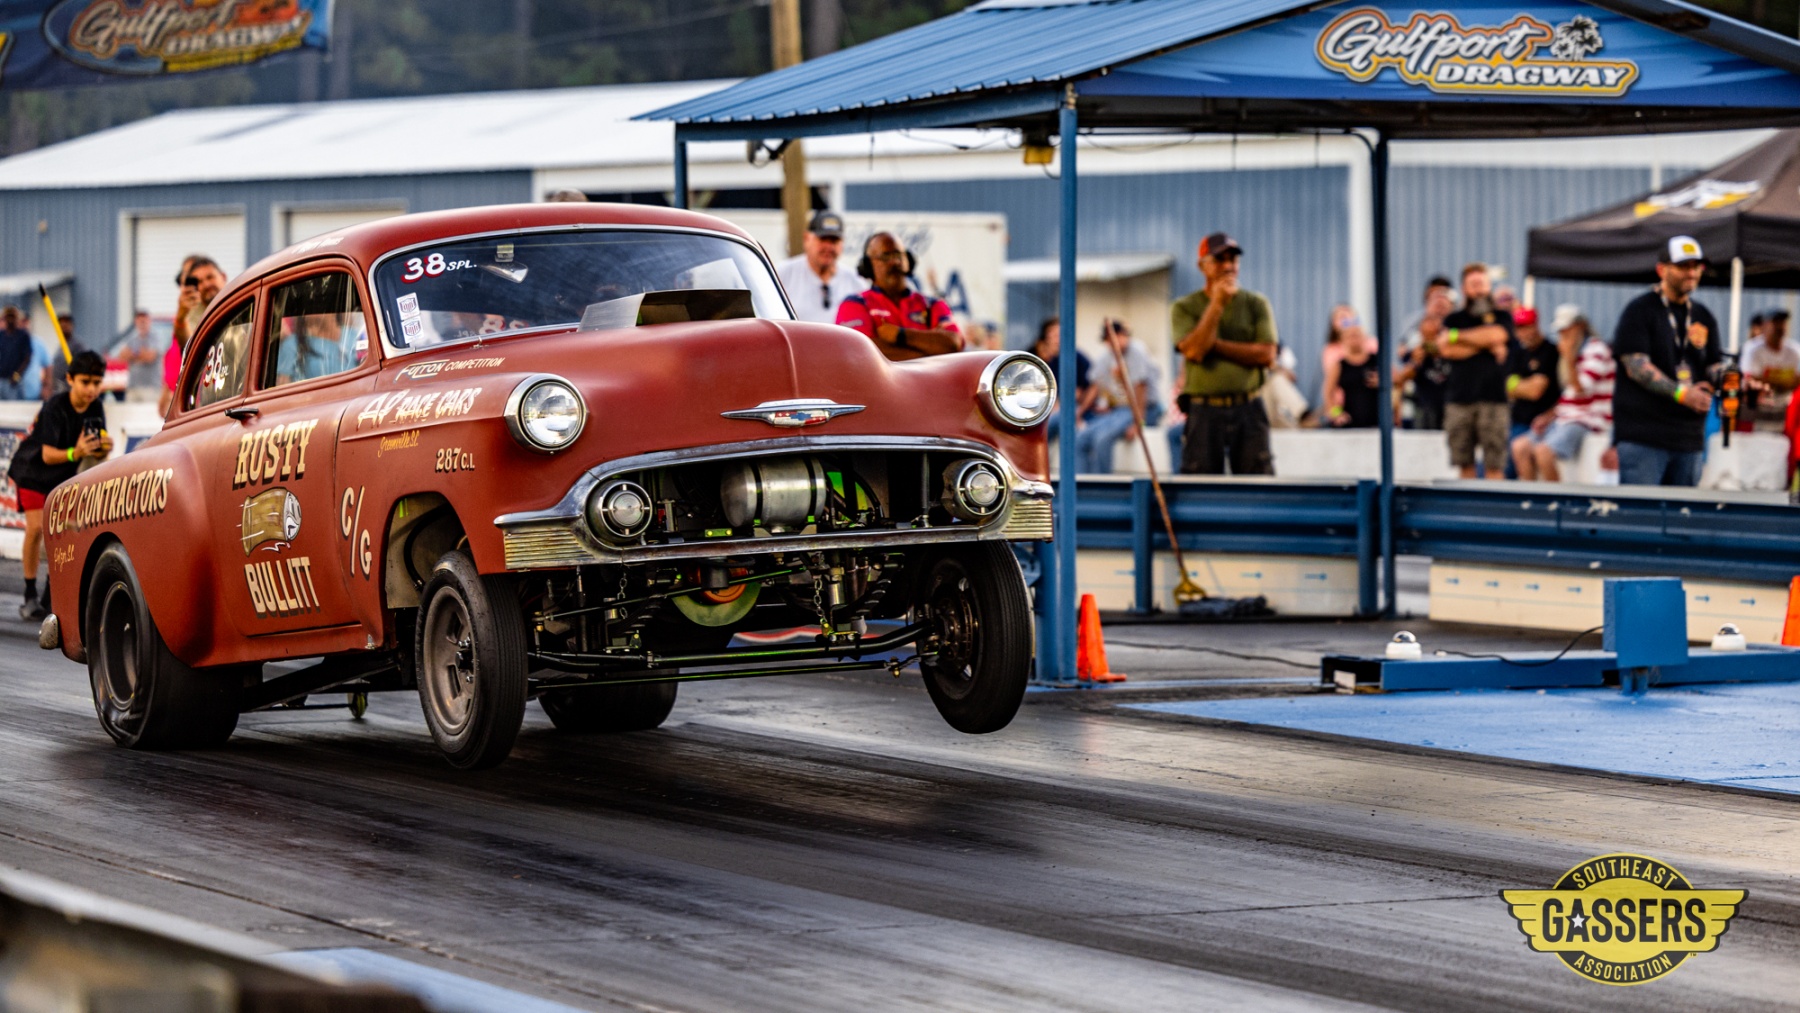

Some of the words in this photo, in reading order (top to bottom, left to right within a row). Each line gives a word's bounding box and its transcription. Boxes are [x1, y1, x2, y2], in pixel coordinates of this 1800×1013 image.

[1326, 15, 1547, 73] Gulfport
[1435, 63, 1629, 86] DRAGWAY
[401, 252, 446, 284] 38
[204, 342, 225, 388] 38
[394, 358, 450, 383] FULTON
[444, 357, 506, 372] COMPETITION
[394, 392, 442, 422] RACE
[435, 387, 483, 418] CARS
[233, 419, 319, 488] RUSTY
[435, 447, 462, 473] 287
[76, 468, 173, 530] CONTRACTORS
[244, 556, 320, 617] BULLITT
